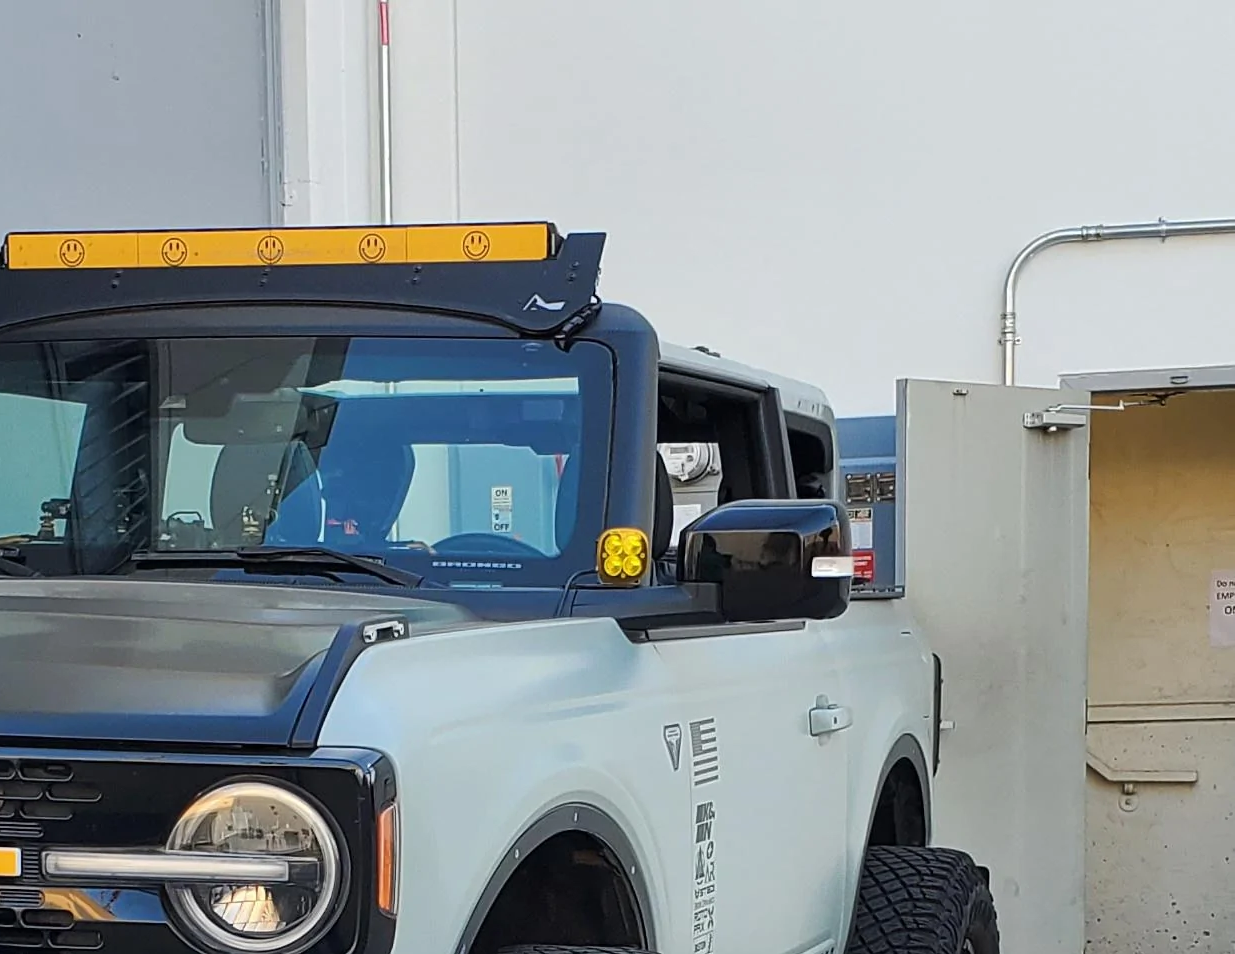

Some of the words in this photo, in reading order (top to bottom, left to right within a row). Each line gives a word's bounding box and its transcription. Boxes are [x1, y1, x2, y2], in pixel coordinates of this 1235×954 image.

[495, 489, 508, 497] ON
[493, 523, 510, 531] OFF
[1216, 580, 1227, 588] Do
[1216, 592, 1235, 600] EMP
